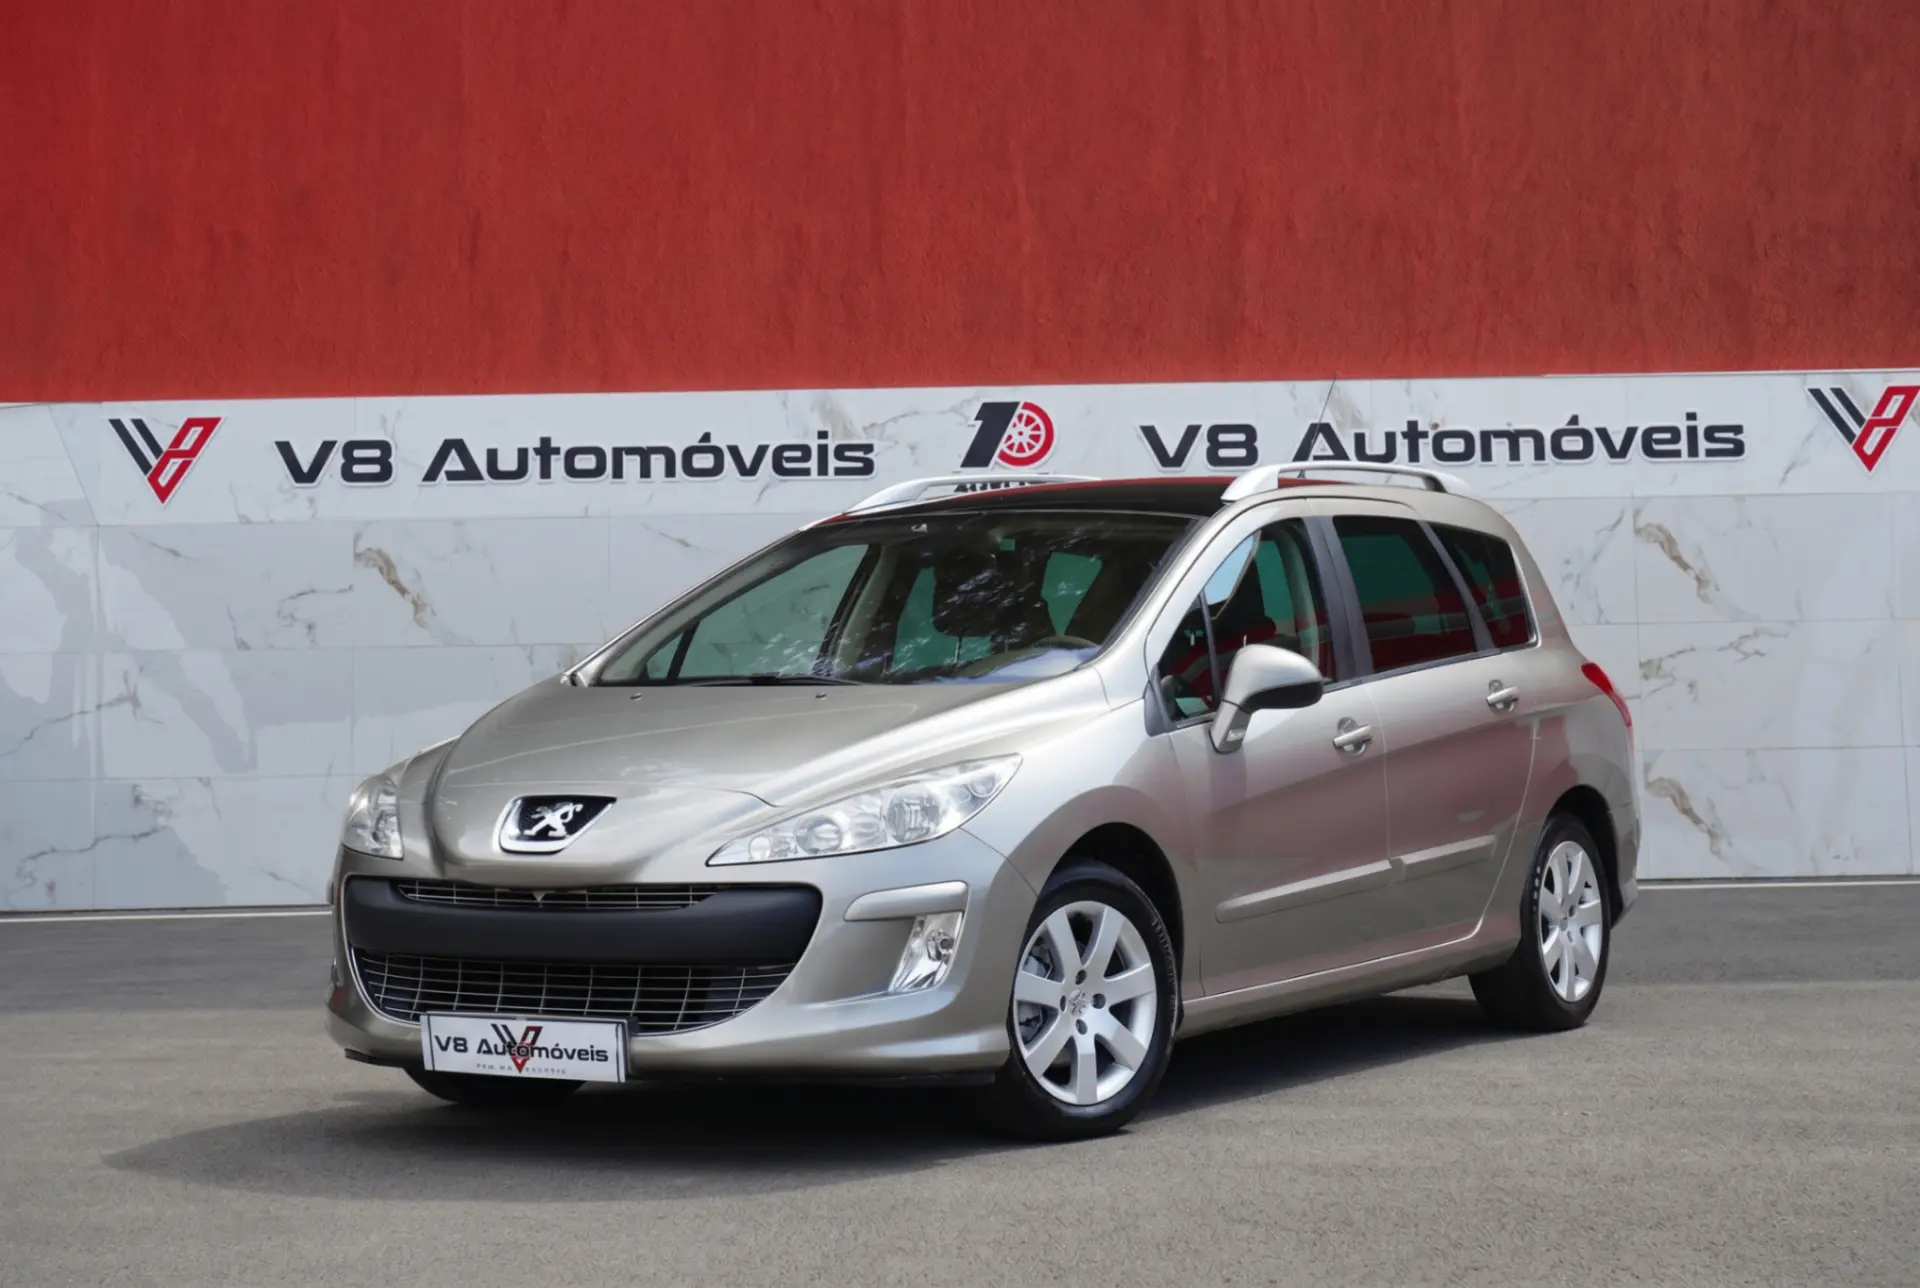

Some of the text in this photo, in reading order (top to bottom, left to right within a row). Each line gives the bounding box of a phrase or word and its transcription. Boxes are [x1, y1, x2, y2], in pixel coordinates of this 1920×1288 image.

[274, 430, 876, 484] V8 Automóveis
[1141, 412, 1745, 468] V8 Automóveis
[434, 1035, 609, 1062] V8 Automóveis
